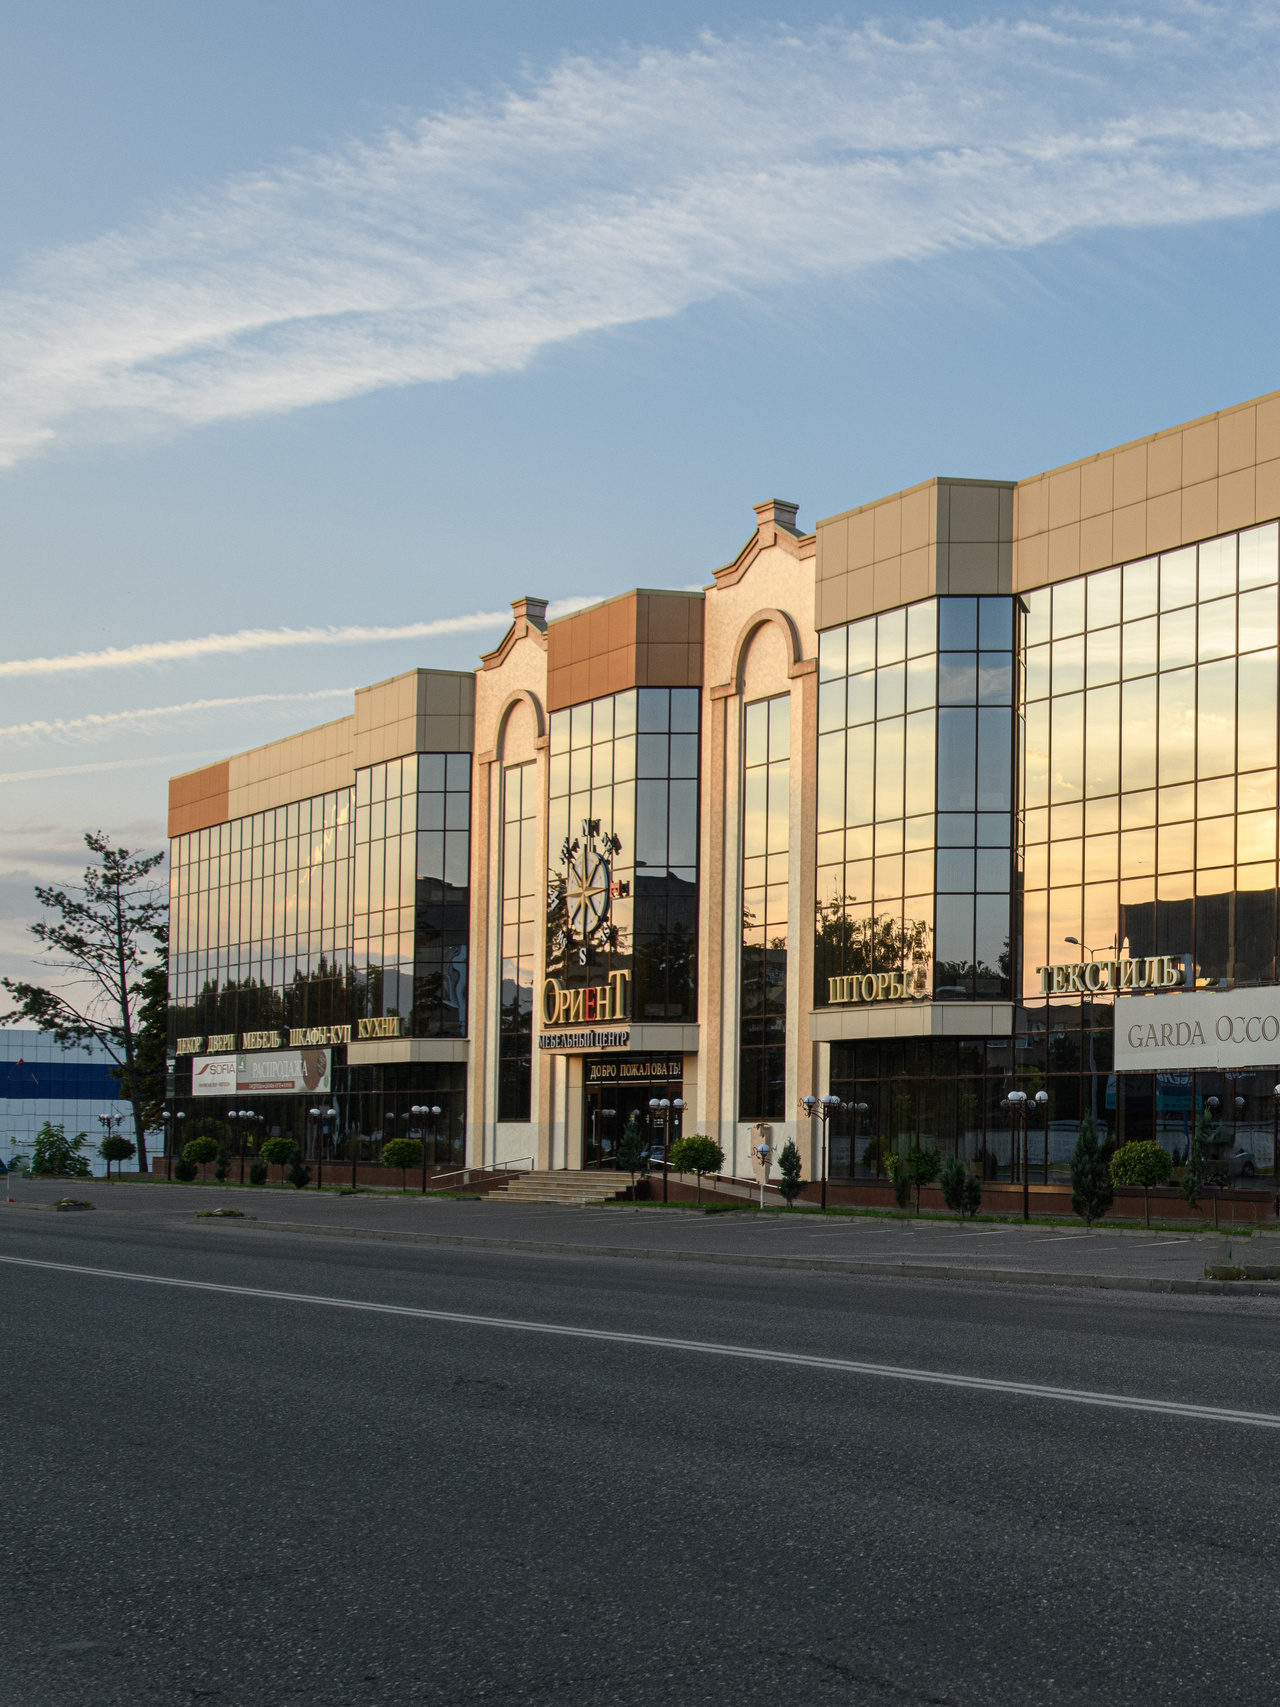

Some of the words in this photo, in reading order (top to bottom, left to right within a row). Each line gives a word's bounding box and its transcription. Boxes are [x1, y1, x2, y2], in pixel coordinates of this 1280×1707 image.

[1036, 955, 1184, 994] ТЕКСТИЛЬ
[828, 970, 911, 1003] ШТОРЫ
[358, 1017, 401, 1038] КУХНИ
[1127, 1020, 1207, 1048] GARDA
[176, 1037, 204, 1056] ДЕКОР
[207, 1034, 237, 1054] ДВЕРИ
[242, 1031, 282, 1050] МЕБЕЛЬ
[539, 1030, 594, 1049] МЕБЕЛЬНЫЙ
[595, 1031, 629, 1050] ЦЕНТР
[210, 1063, 236, 1075] SOFIA
[252, 1060, 308, 1078] РАСПРОДАЖА
[590, 1064, 617, 1080] ДОБРО
[620, 1063, 681, 1077] ПОЖАЛОВАТЬ!
